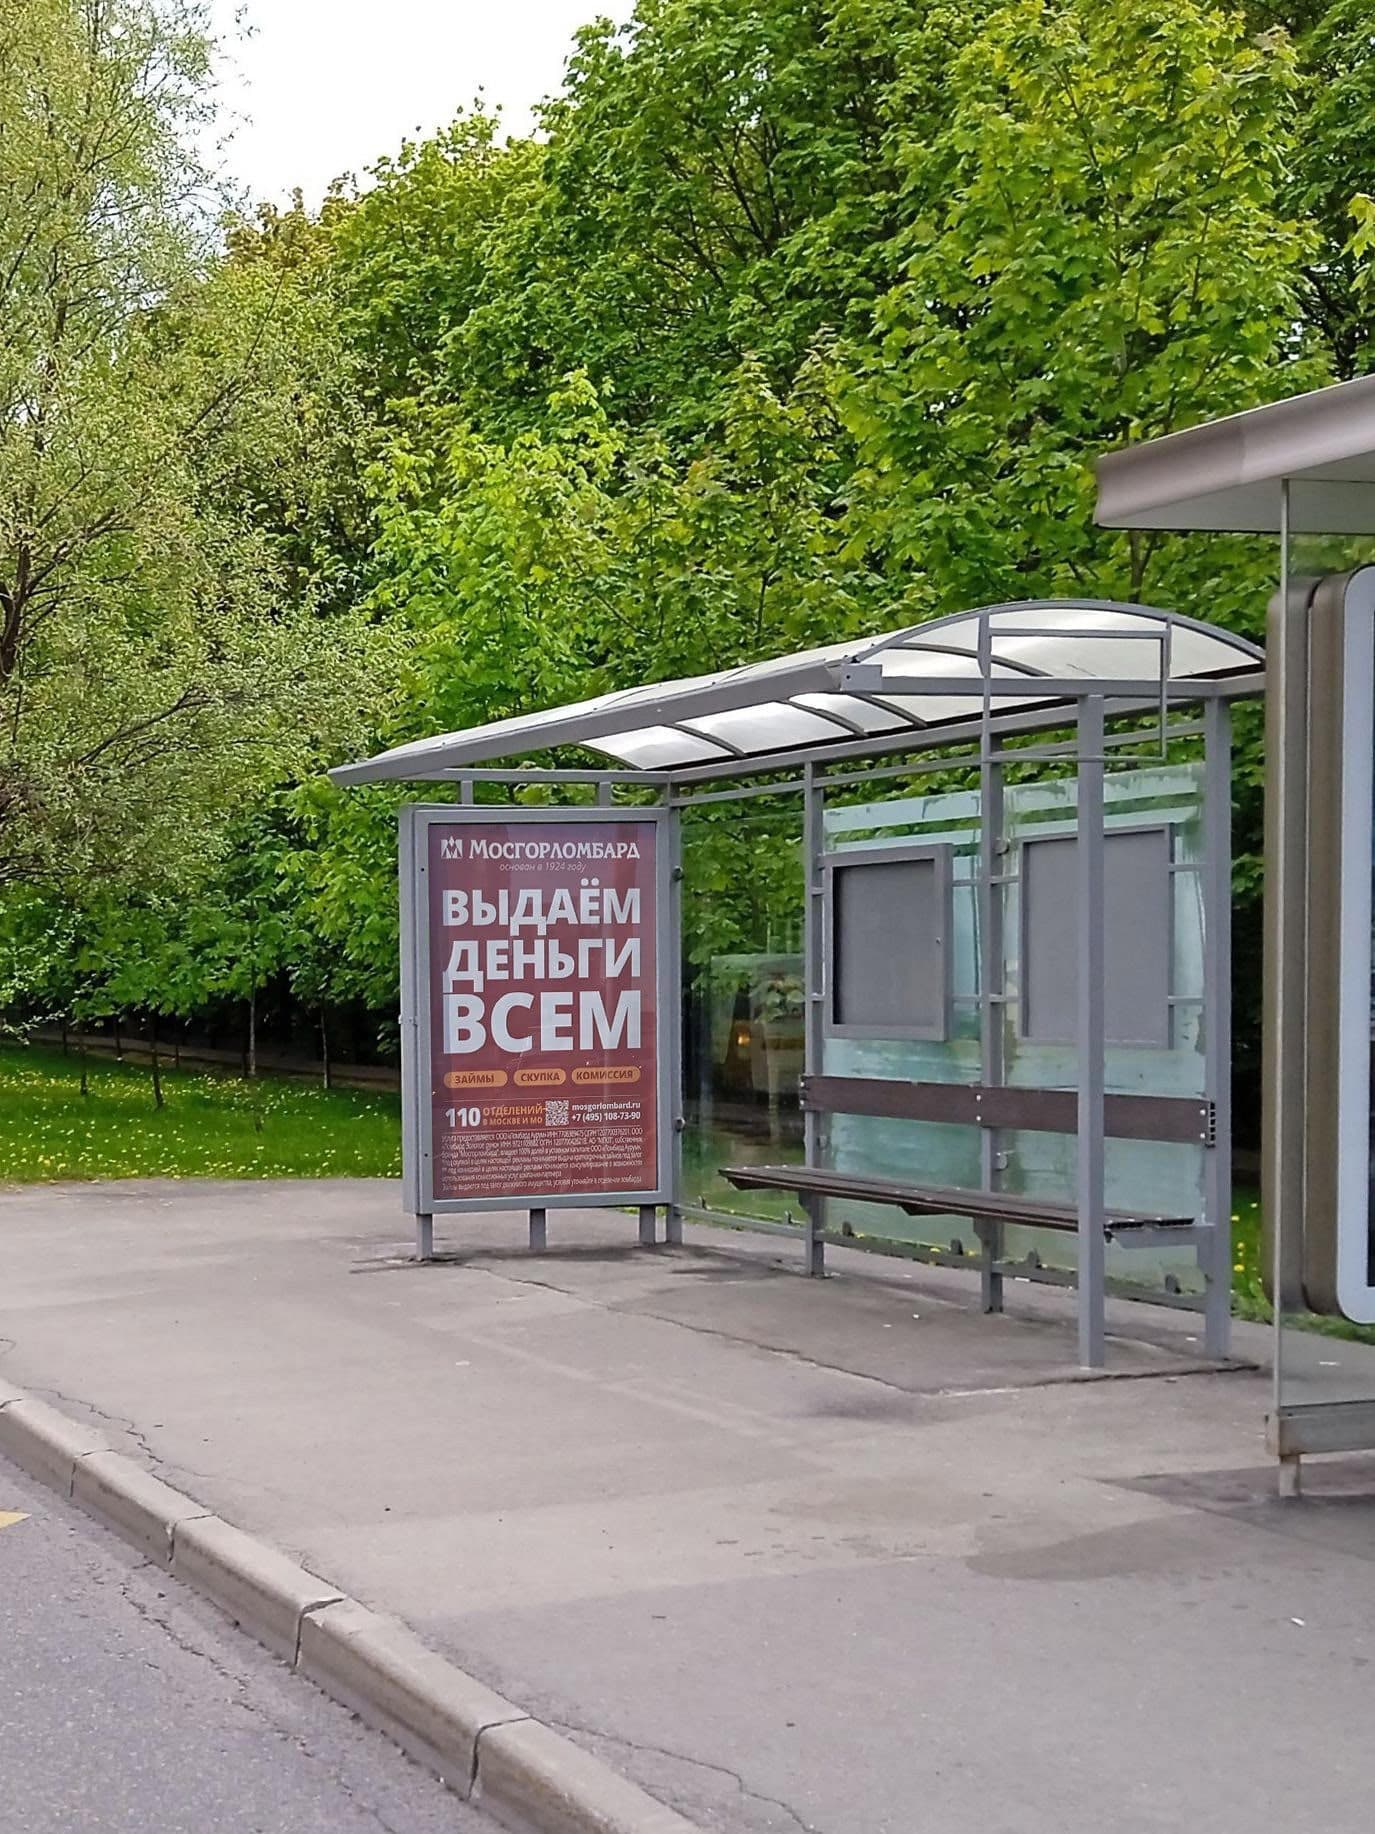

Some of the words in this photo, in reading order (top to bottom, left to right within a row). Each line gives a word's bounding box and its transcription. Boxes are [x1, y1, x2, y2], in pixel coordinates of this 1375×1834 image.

[499, 863, 536, 872] основан
[545, 861, 565, 872] 1924
[567, 861, 587, 874] году
[442, 878, 641, 937] ВЫДАЁМ
[442, 938, 641, 993] ДЕНЬГИ
[442, 989, 642, 1055] ВСЕМ
[454, 1072, 495, 1085] ЗАЙМЫ
[520, 1072, 560, 1083] СКУПКА
[576, 1069, 633, 1081] КОМИССИЯ
[571, 1100, 641, 1112] mosgorlombard.ru
[445, 1106, 481, 1128] 110
[482, 1103, 543, 1117] ОТДЕЛЕНИЙ
[482, 1118, 488, 1126] В
[489, 1117, 521, 1126] МОСКВЕ
[522, 1117, 529, 1125] И
[530, 1116, 543, 1125] МО
[571, 1113, 581, 1122] +7
[582, 1112, 603, 1123] (495)
[604, 1111, 641, 1121] 108-73-90
